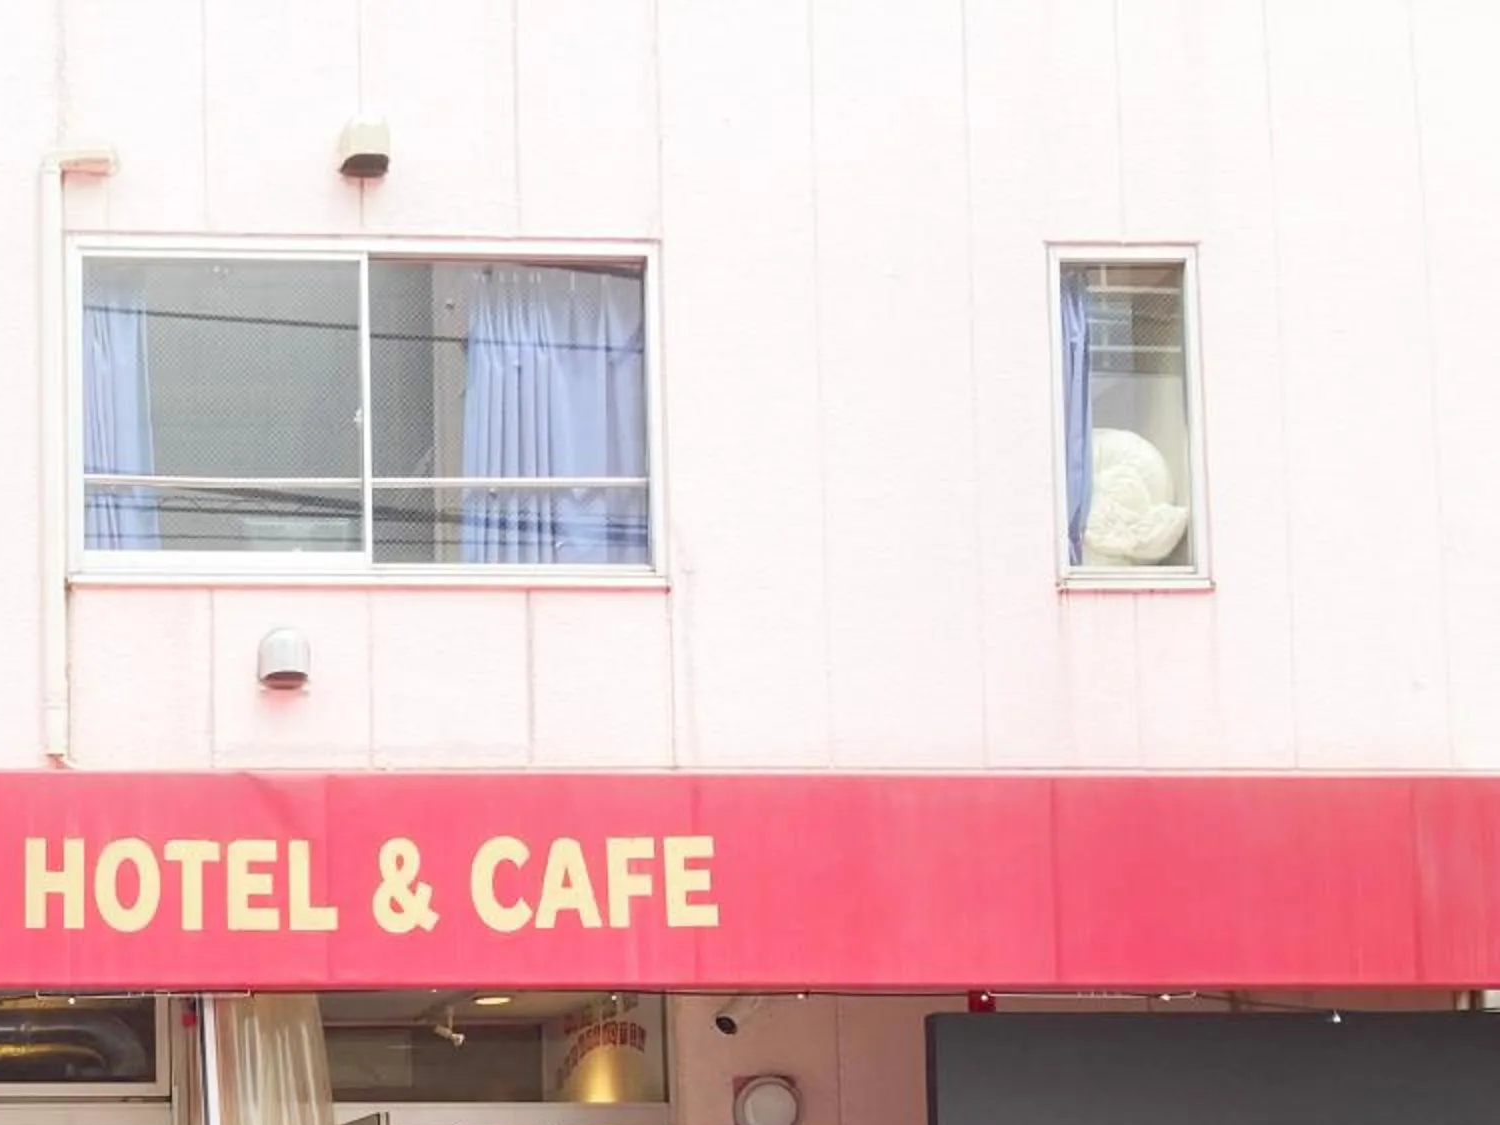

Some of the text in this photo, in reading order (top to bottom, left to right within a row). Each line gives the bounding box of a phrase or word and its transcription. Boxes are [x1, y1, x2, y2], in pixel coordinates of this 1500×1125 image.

[24, 837, 338, 932] HOTEL
[372, 837, 439, 933] &
[470, 836, 719, 932] CAFE
